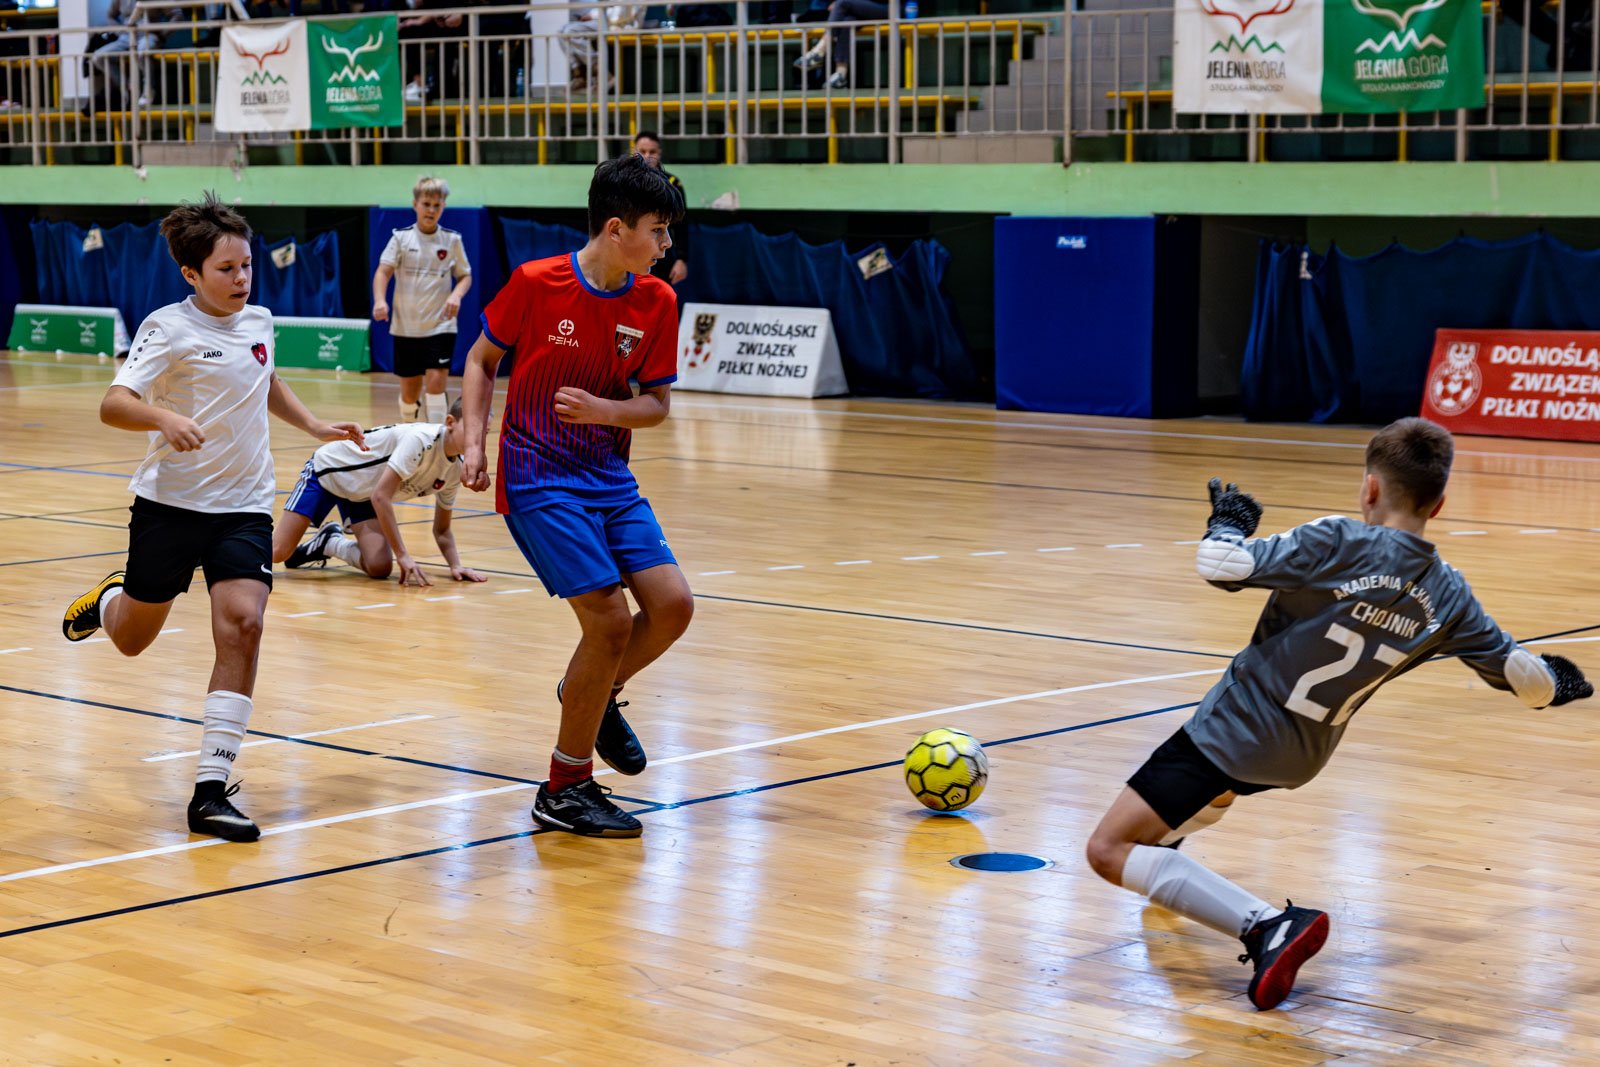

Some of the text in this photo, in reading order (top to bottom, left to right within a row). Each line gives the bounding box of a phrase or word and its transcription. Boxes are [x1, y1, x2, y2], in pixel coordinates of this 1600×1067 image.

[1206, 60, 1252, 79] JELENIA
[1355, 54, 1449, 79] JELENIA GÓRA
[726, 319, 818, 340] DOLNOŚLĄSKI
[548, 334, 580, 348] PEHA
[736, 342, 797, 359] ZWIĄZEK
[203, 350, 223, 359] JAKO
[1490, 341, 1600, 372] DOLNOŚLĄ
[717, 360, 808, 378] PIŁKI NOŻNEJ
[1480, 397, 1541, 417] PIŁKI
[1332, 575, 1402, 601] AKADEMIA
[1350, 601, 1420, 639] CHOJNIK
[212, 748, 237, 763] JAKO
